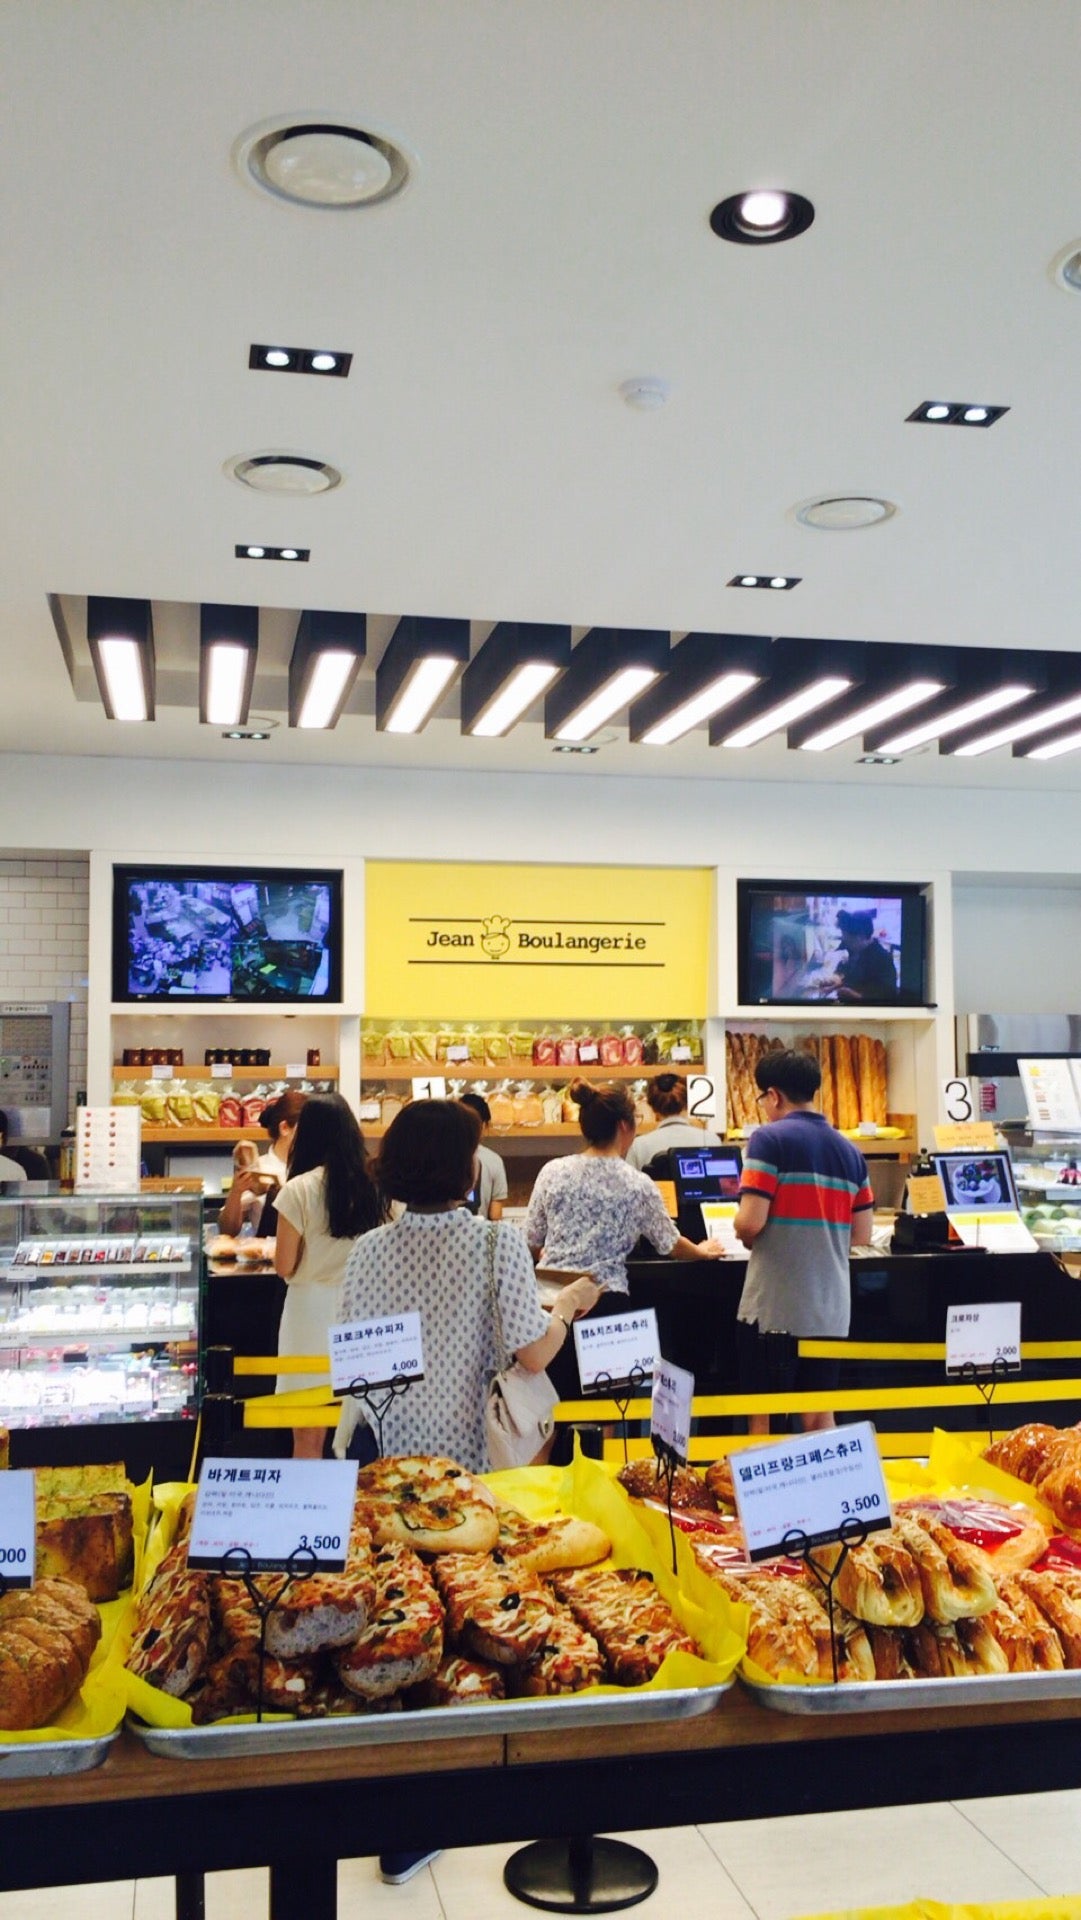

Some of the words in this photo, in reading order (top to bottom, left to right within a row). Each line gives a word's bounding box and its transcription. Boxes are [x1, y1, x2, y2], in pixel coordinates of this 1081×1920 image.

[427, 931, 475, 947] Jean
[518, 932, 647, 954] Boulangerie
[689, 1077, 715, 1118] 2
[945, 1080, 972, 1122] 3
[333, 1322, 404, 1344] 크로크무슈피자
[392, 1359, 418, 1372] 4,000
[739, 1438, 862, 1483] 델리프랑크페스츄리
[207, 1468, 282, 1483] 바게트피자
[841, 1493, 881, 1514] 3,500
[299, 1535, 341, 1550] 3,500
